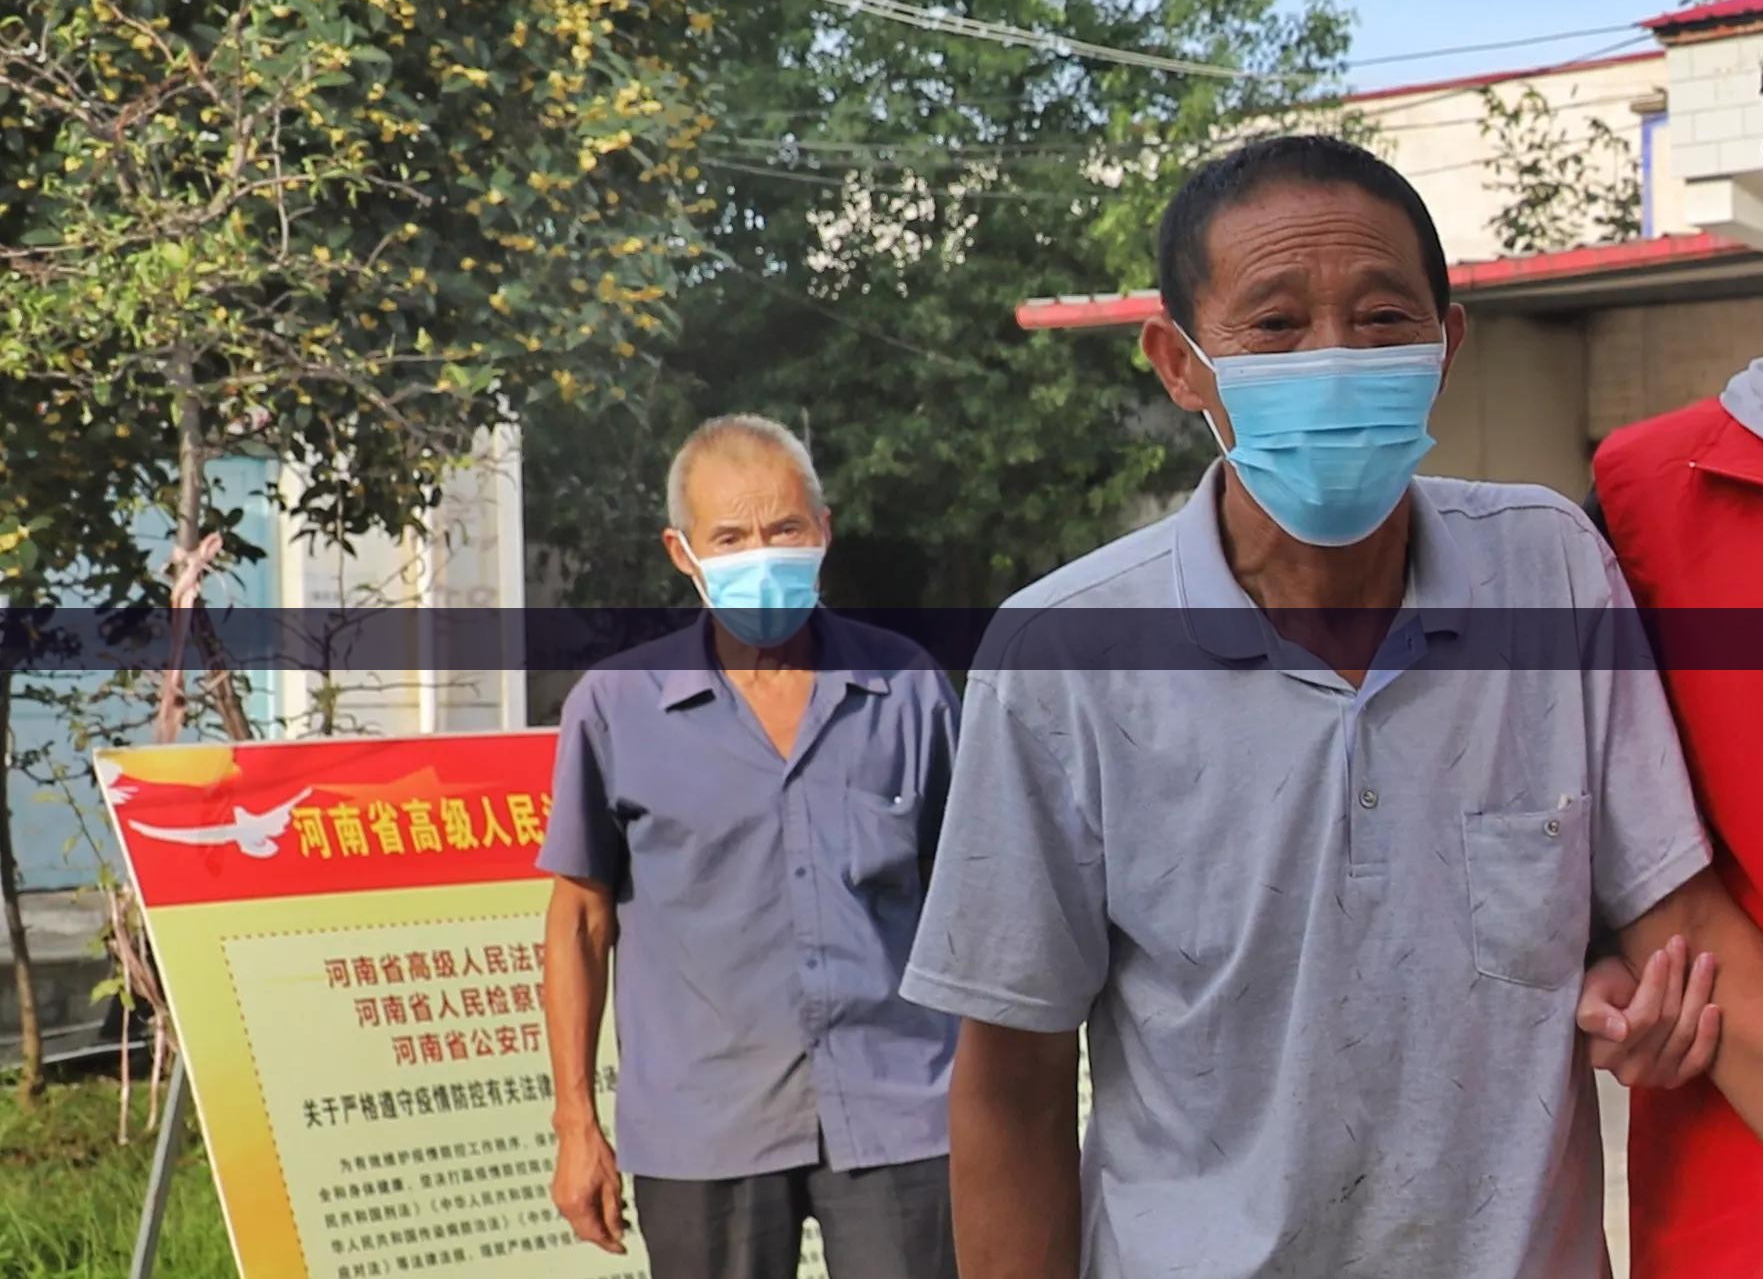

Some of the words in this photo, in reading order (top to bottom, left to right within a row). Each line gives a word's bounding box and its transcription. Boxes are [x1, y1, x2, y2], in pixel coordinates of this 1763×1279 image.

[291, 792, 553, 859] 河南省高级人民
[392, 1023, 541, 1067] 河南省公安厅
